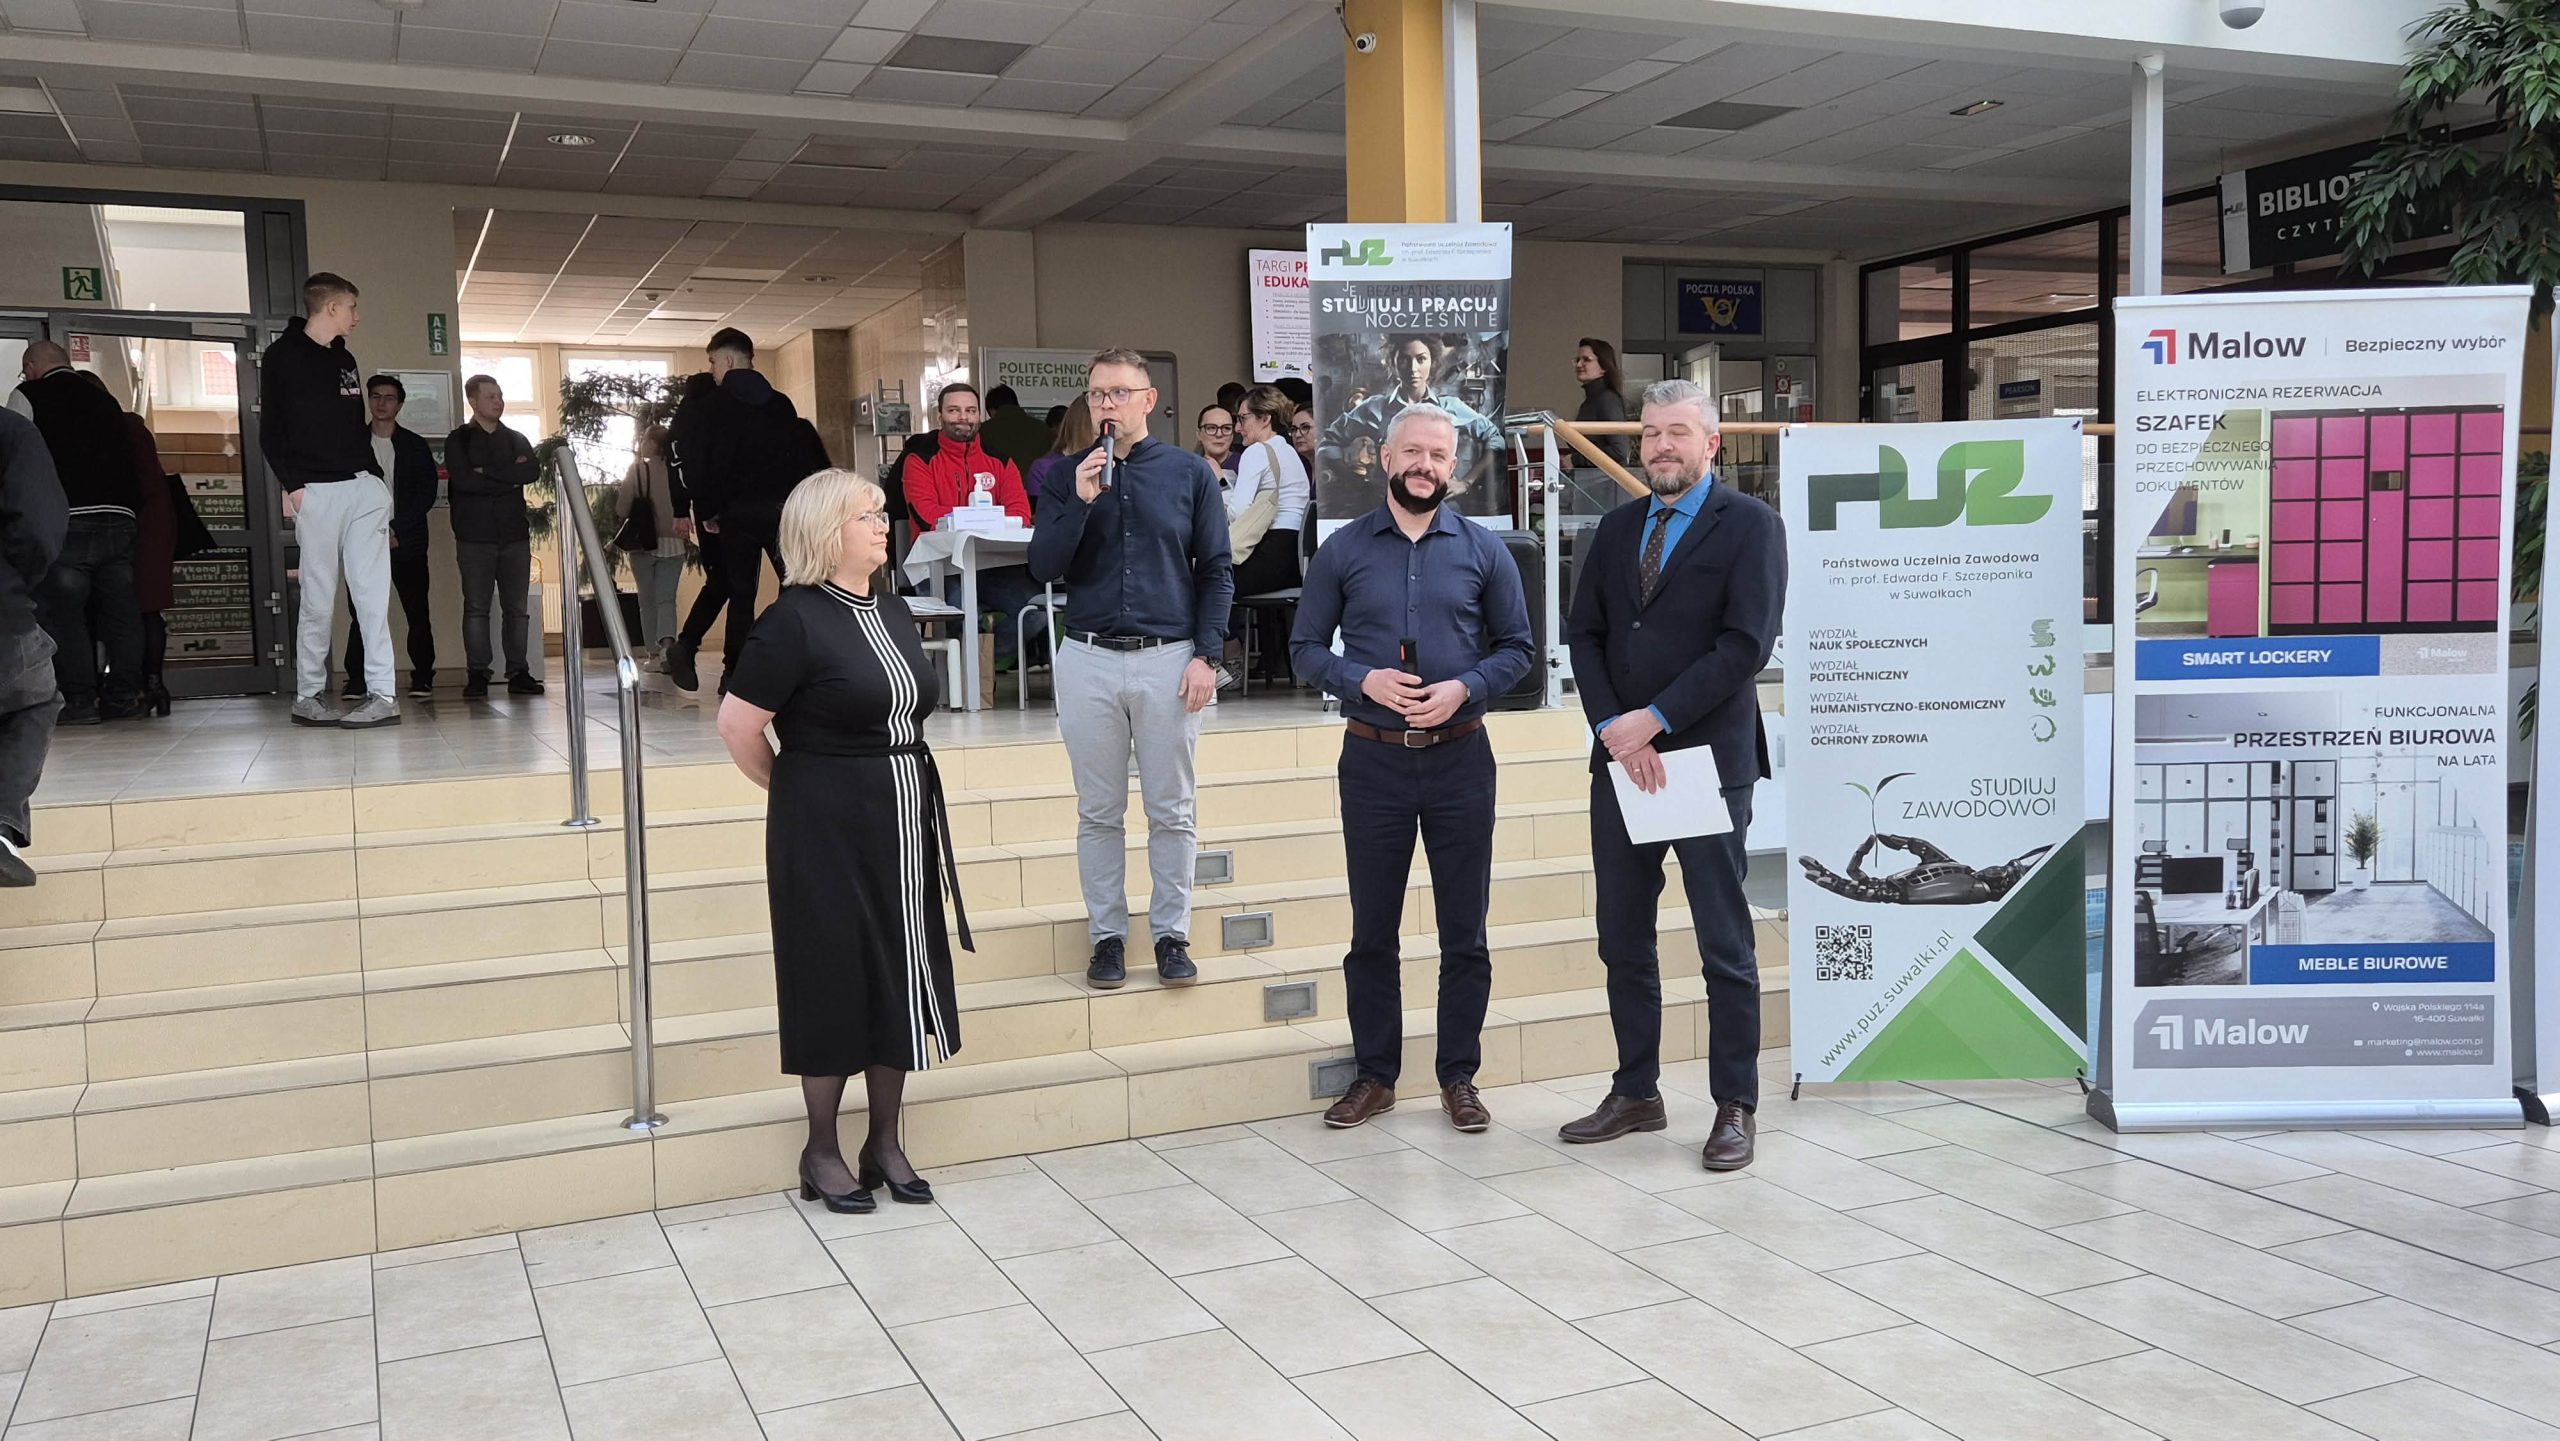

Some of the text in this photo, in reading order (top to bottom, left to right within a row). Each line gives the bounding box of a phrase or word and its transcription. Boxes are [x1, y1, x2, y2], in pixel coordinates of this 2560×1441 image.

[1256, 260, 1291, 273] TARGI
[1366, 284, 1497, 298] BEZPŁATNE STUDIA
[1685, 284, 1755, 296] POCZTA POLSKA
[1408, 297, 1414, 313] I
[1421, 296, 1498, 313] PRACUJ
[433, 315, 443, 354] AED
[2188, 330, 2508, 361] Malow Bezpieczny wybór
[999, 375, 1049, 388] STREFA
[2136, 384, 2383, 403] ELEKTRONICZNA REZERWACJA
[2136, 414, 2227, 433] SZAFEK
[2136, 440, 2273, 455] DO BEZPIECZNEGO
[2136, 460, 2279, 474] PRZECHOWYWANIA
[2136, 477, 2245, 493] DOKUMENTÓW
[1822, 551, 2040, 570] Państwowa Uczelnia Zawodowa
[1829, 568, 2034, 588] im. prof. Edwarda F. Szczepanika
[1889, 586, 1972, 600] w Suwałkach
[1809, 629, 1858, 640] WYDZIAŁ
[1809, 637, 1928, 651] NAUK SPOŁECZNYCH
[2182, 649, 2332, 667] SMART LOCKERY
[2431, 647, 2468, 658] Malow
[1809, 660, 1859, 672] WYDZIAŁ
[1810, 670, 1909, 682] POLITECHNICZNY
[1810, 692, 1859, 703] WYDZIAŁ
[1810, 699, 2006, 715] HUMANISTYCZNO-EKONOMICZNY
[2375, 703, 2497, 719] FUNKCJONALNA
[1810, 724, 1860, 735] WYDZIAŁ
[1811, 733, 1928, 746] OCHRONY ZDROWIA
[2233, 726, 2497, 749] PRZESTRZEŃ BIUROWA
[2437, 754, 2497, 767] NA LATA
[1970, 776, 2056, 797] STUDIUJ
[1902, 798, 2057, 820] ZAWODOWO!
[2298, 955, 2448, 972] MEBLE BIUROWE
[1820, 928, 1955, 1067] www.puz.suwalki.pl
[2383, 1003, 2485, 1013] Wojska Polskiego 114a
[2447, 1014, 2485, 1023] Suwałki
[2195, 1017, 2310, 1046] Malow
[2367, 1038, 2484, 1047] marketing@malow.com.pl
[2416, 1048, 2484, 1057] www.malow.pl
